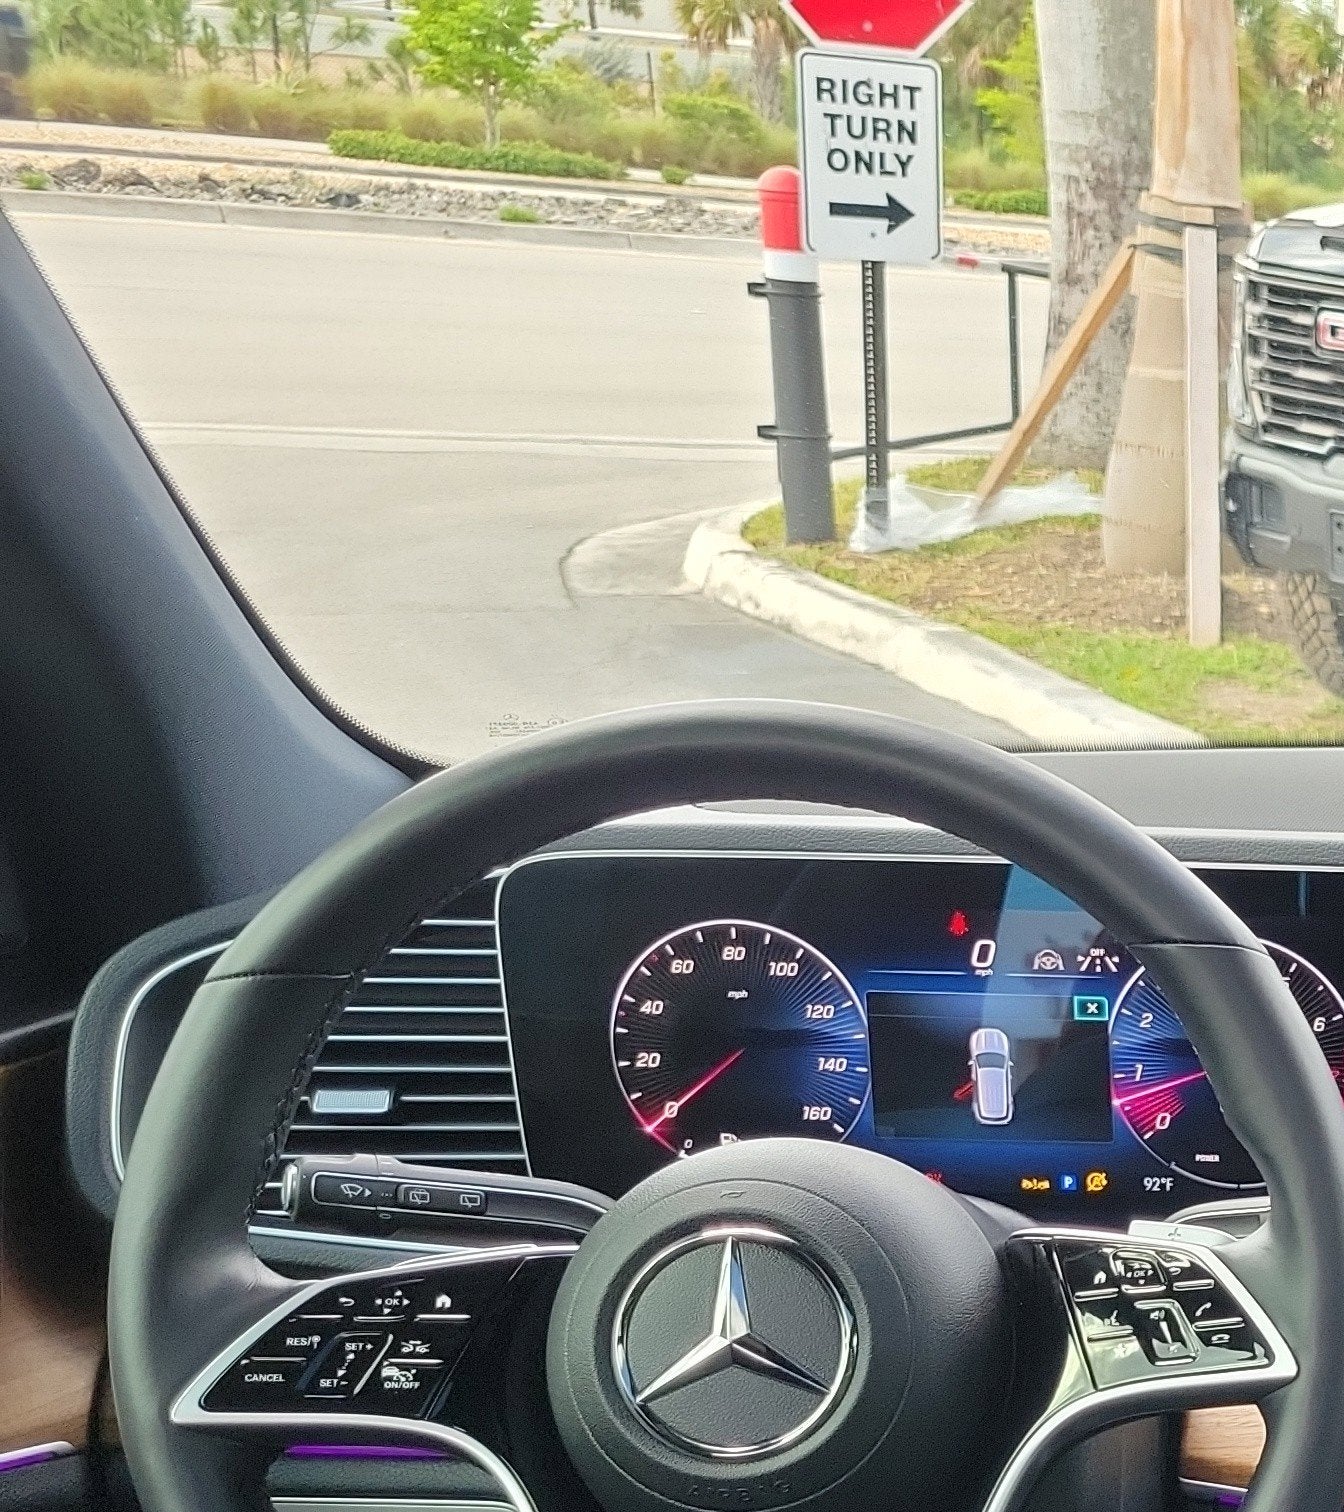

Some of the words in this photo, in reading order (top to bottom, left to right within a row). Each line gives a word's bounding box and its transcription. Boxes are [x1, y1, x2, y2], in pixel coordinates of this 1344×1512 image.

[815, 76, 922, 110] RIGHT
[823, 112, 917, 146] TURN
[826, 148, 914, 178] ONLY
[722, 946, 746, 961] 80
[971, 939, 996, 967] 0
[671, 960, 695, 974] 60
[768, 962, 799, 977] 100
[640, 1001, 664, 1015] 40
[806, 1004, 835, 1018] 120
[1140, 1012, 1154, 1028] 2
[1313, 1017, 1326, 1032] 6
[636, 1053, 661, 1067] 20
[818, 1057, 847, 1072] 140
[1134, 1064, 1144, 1081] 1
[665, 1102, 678, 1117] 0
[803, 1106, 832, 1121] 160
[1156, 1113, 1171, 1130] 0
[1143, 1177, 1174, 1192] 92°F
[385, 1297, 400, 1306] OK
[244, 1374, 286, 1382] CANCEL
[319, 1379, 338, 1387] SET
